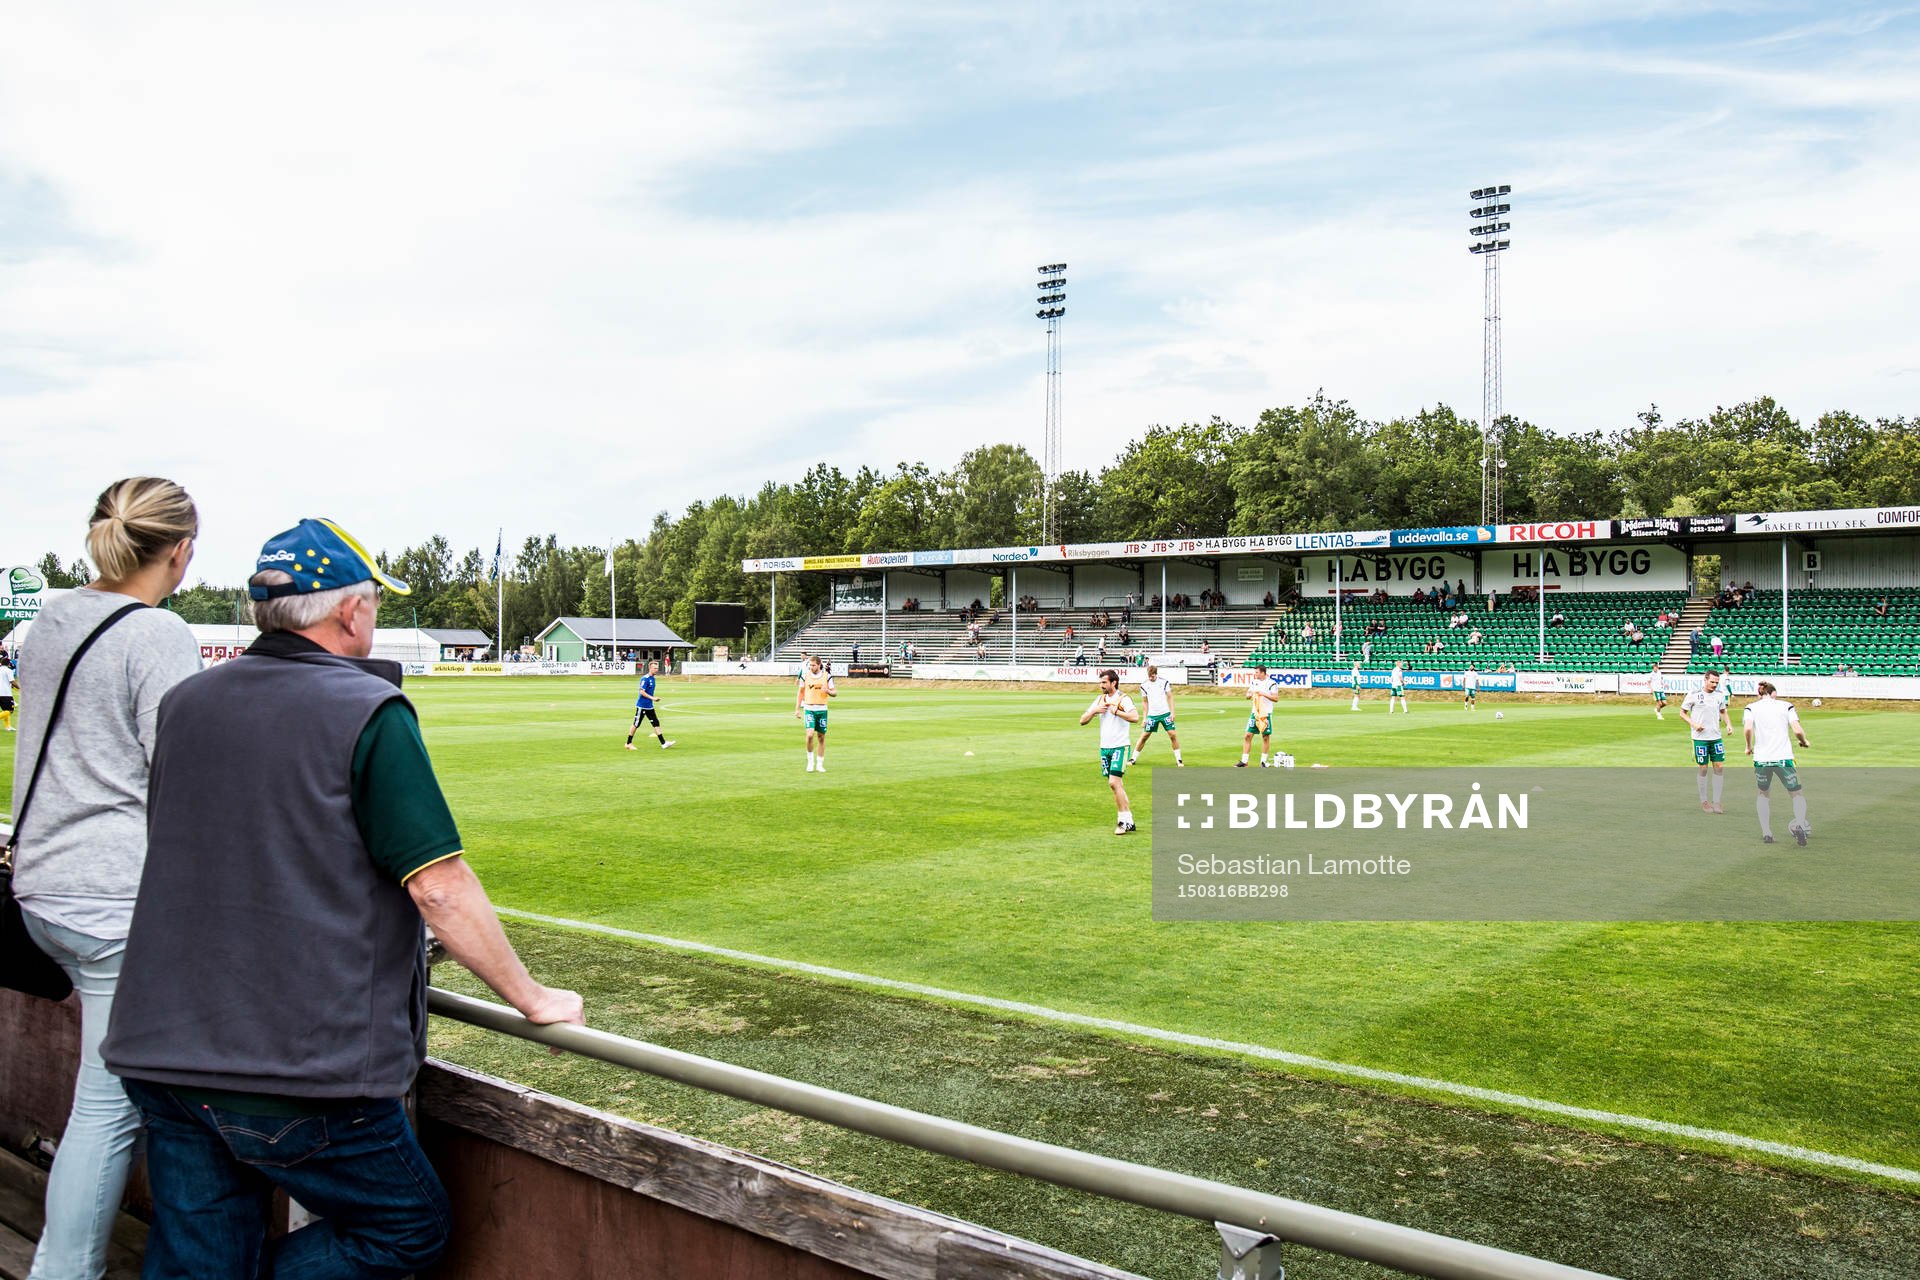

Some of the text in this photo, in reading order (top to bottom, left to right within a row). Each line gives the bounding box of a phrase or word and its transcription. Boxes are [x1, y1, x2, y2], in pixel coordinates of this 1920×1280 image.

[1655, 518, 1679, 533] Björks
[1765, 519, 1867, 532] BAKER TILLY SEK
[1397, 530, 1469, 544] uddevalla.se
[1509, 522, 1595, 541] RICOH
[1178, 541, 1195, 552] JTB
[1205, 538, 1246, 549] H.A BYGG
[1250, 536, 1292, 547] H.A BYGG
[1295, 534, 1354, 549] LLENTAB
[1068, 548, 1110, 558] Riksbyggen
[1123, 544, 1140, 554] JTB
[1151, 543, 1167, 553] JTB
[992, 552, 1028, 561] Nordea
[1806, 553, 1817, 569] B
[763, 560, 796, 569] NORISOL
[1569, 548, 1651, 577] BYGG
[1375, 555, 1446, 582] BYGG
[1297, 569, 1305, 581] A
[605, 662, 625, 670] BYGG
[1057, 667, 1088, 675] RICOH
[1233, 673, 1308, 685] INTSPORT
[1312, 674, 1331, 683] HELA
[1333, 674, 1368, 684] SVERES
